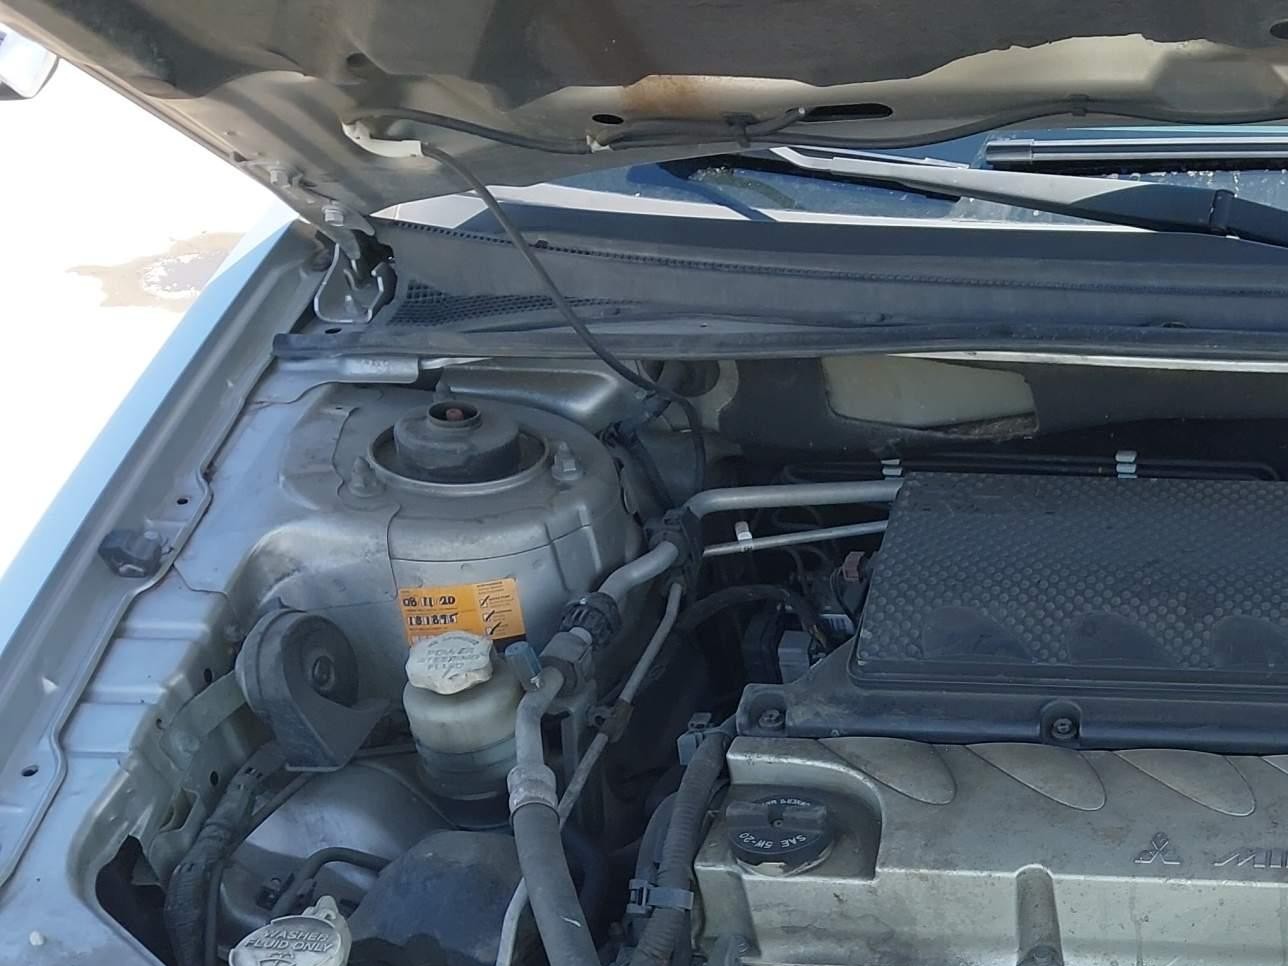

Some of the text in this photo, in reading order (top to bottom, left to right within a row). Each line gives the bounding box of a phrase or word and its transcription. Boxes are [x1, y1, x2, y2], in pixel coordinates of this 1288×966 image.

[739, 832, 807, 849] SAE 5W-20
[264, 929, 329, 942] WASHER
[244, 938, 333, 953] FLUID ONLY
